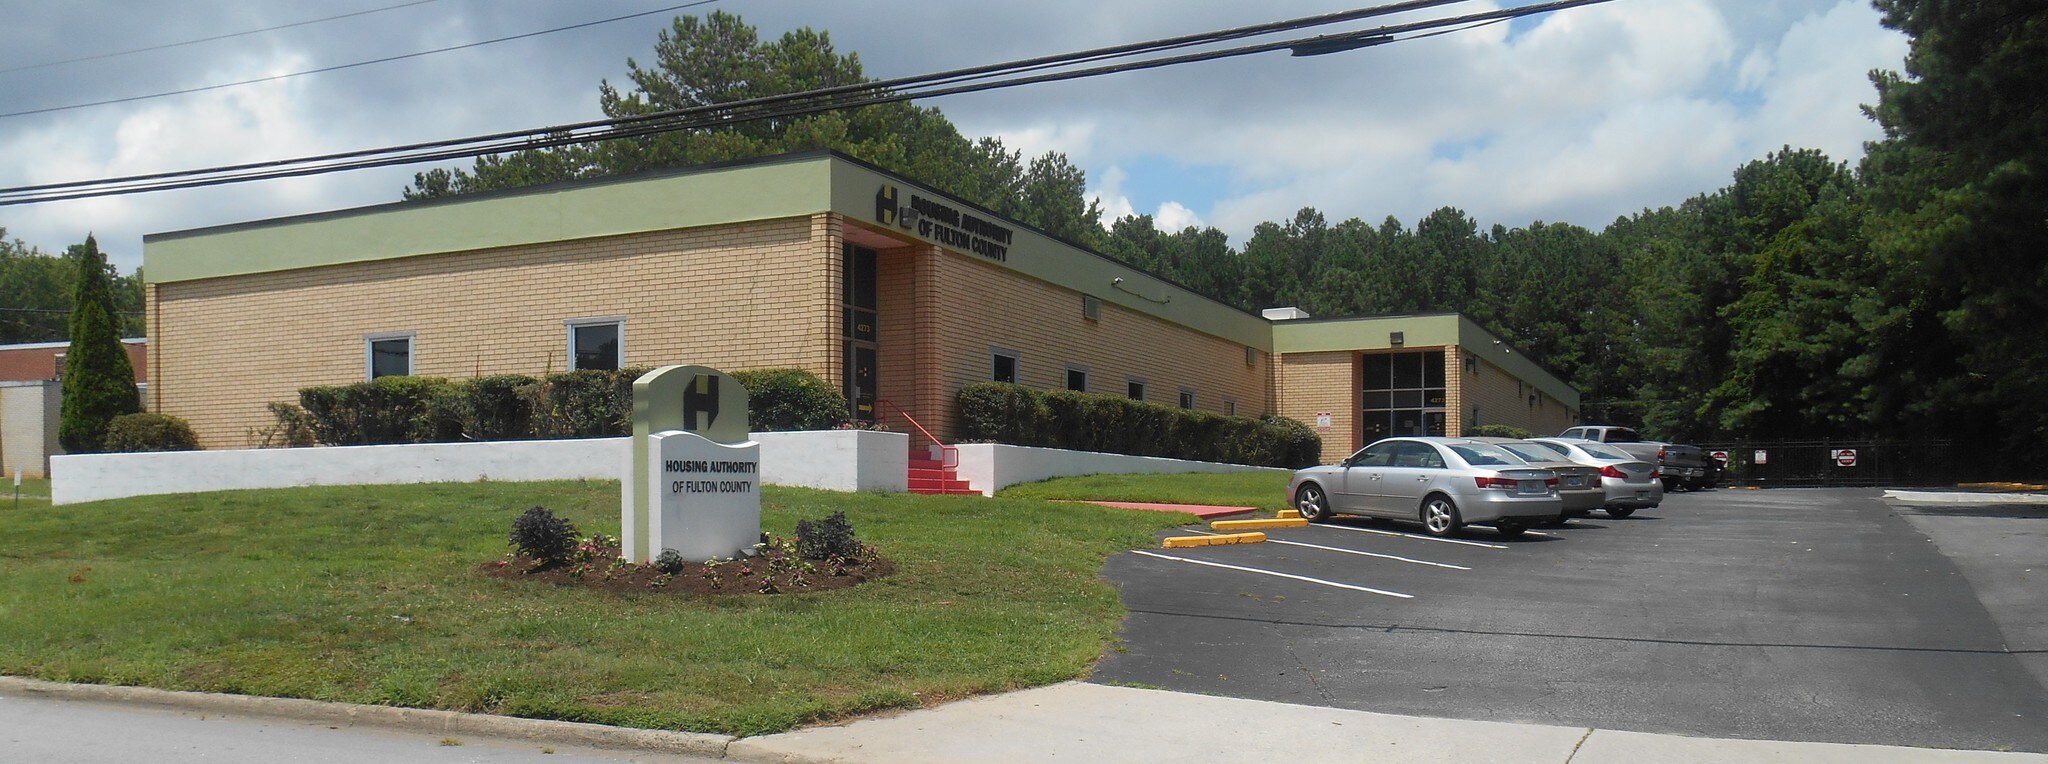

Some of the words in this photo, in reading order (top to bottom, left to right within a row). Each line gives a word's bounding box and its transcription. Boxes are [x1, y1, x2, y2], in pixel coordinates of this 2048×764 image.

[911, 195, 960, 227] HOUSING
[961, 213, 1013, 245] AUTHORITY
[918, 219, 933, 237] OF
[934, 223, 970, 250] FULTON
[972, 236, 1007, 262] COUNTY
[666, 460, 708, 473] HOUSING
[710, 461, 757, 474] AUTHORITY
[672, 481, 684, 493] OF
[686, 481, 718, 493] FULTON
[720, 481, 752, 493] COUNTY
